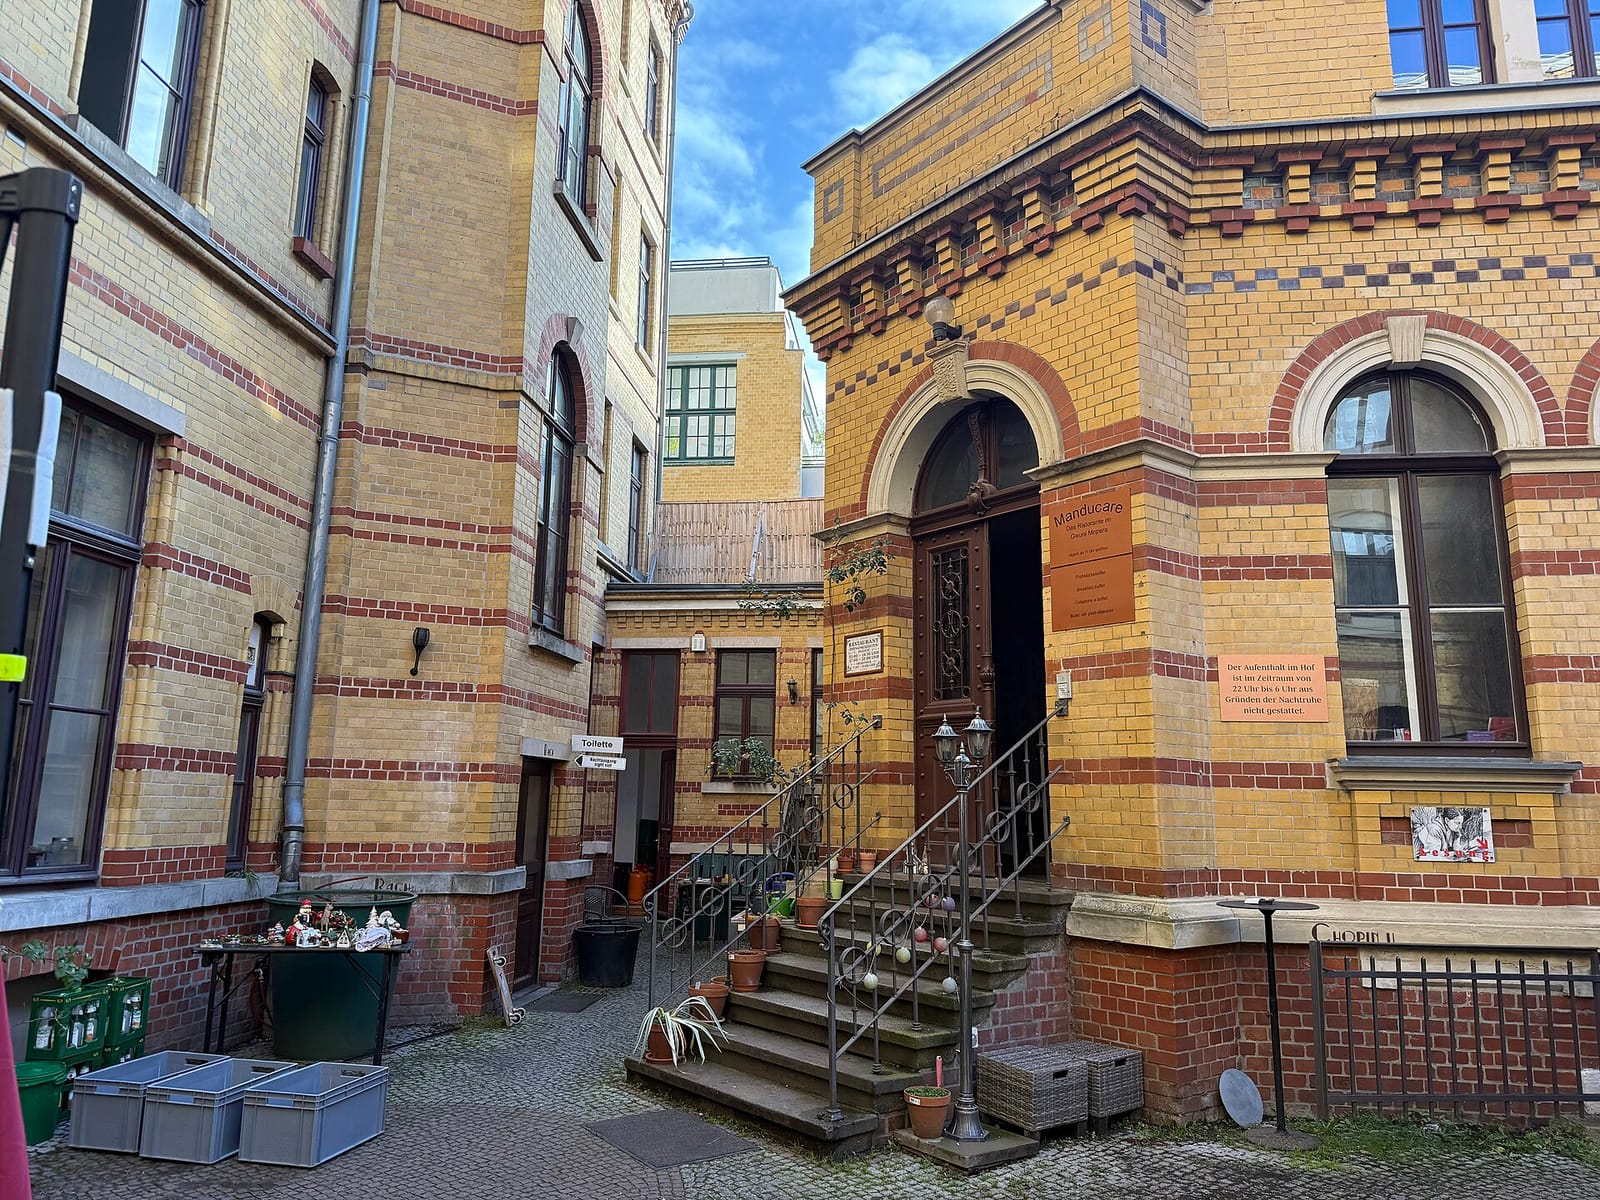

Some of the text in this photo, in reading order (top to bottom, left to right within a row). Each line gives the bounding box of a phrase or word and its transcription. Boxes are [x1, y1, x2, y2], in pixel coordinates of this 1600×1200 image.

[1053, 502, 1123, 528] Manducare
[1266, 707, 1305, 715] gestattet.
[582, 739, 613, 748] Toilette
[1418, 847, 1489, 861] Lesung
[1311, 922, 1379, 943] CHOPIN
